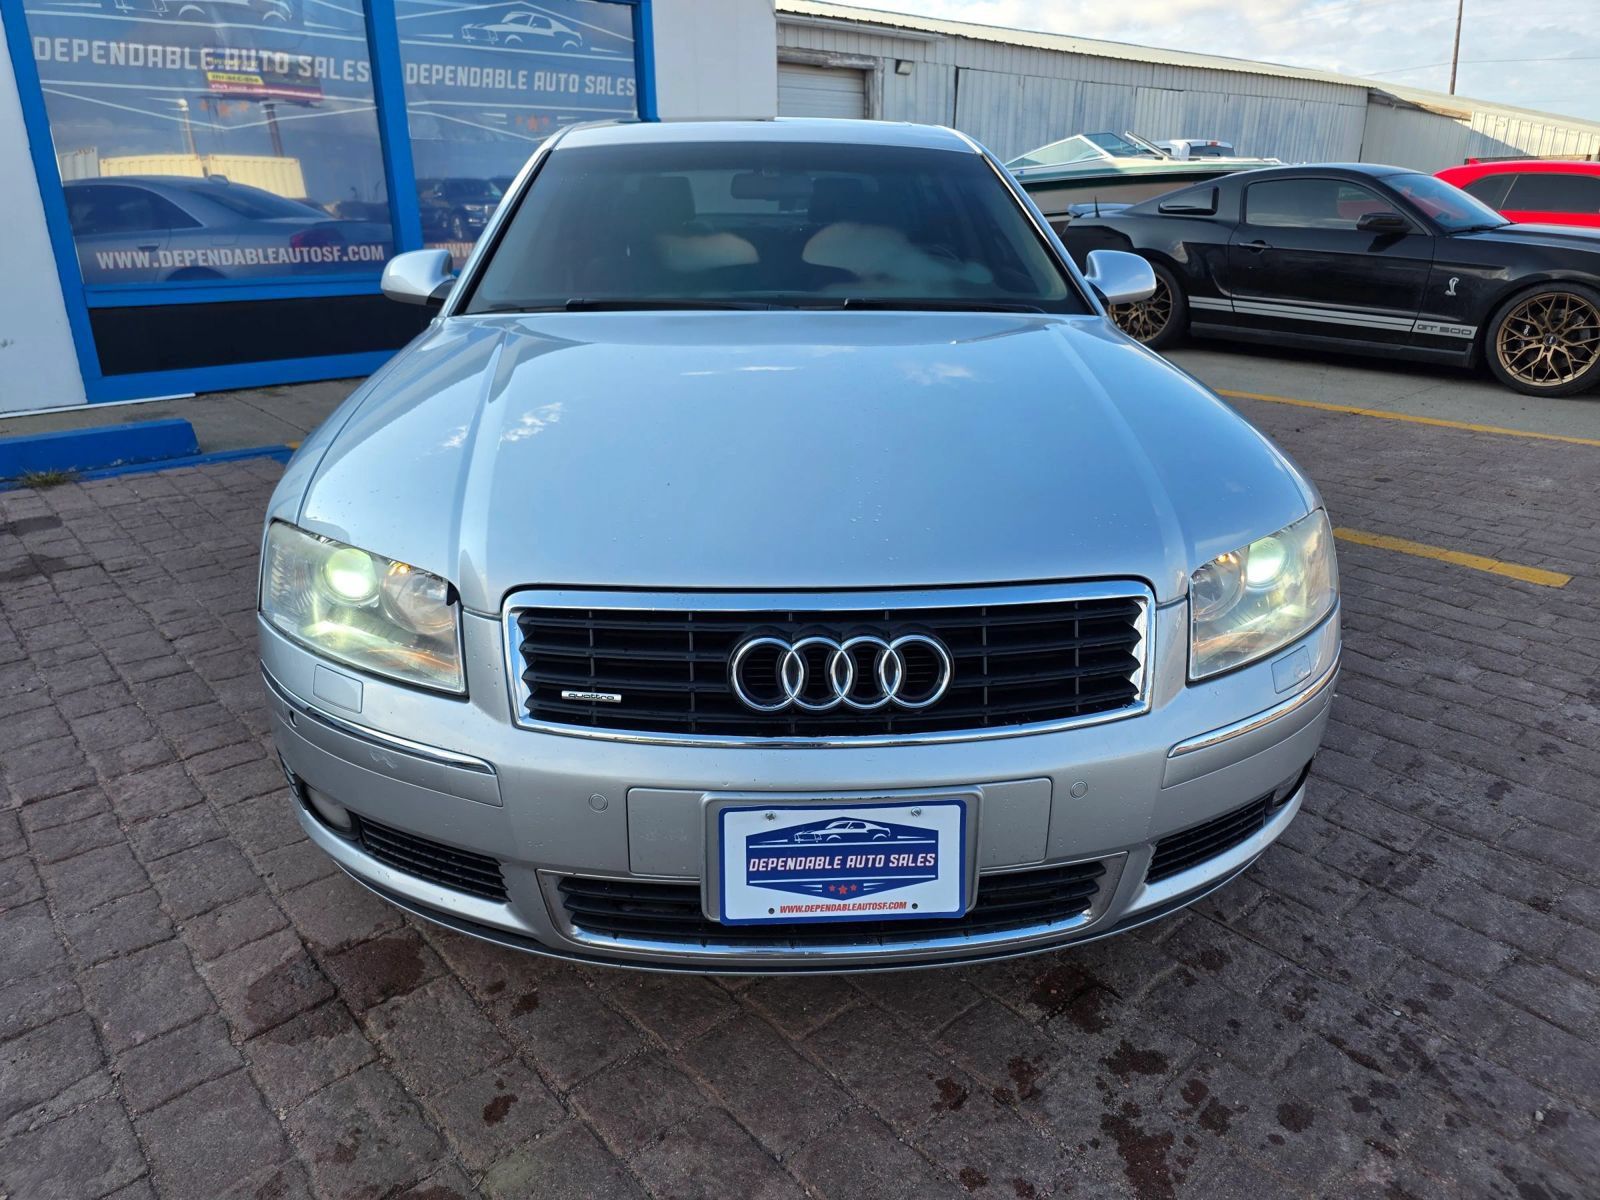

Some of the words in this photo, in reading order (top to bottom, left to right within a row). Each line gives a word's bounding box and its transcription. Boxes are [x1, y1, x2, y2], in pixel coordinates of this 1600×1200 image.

[34, 36, 214, 71] DEPENDABLE
[223, 47, 289, 74] AUTO
[297, 55, 371, 83] SALES
[405, 62, 528, 90] DEPENDABLE
[533, 71, 580, 92] AUTO
[584, 75, 636, 96] SALES
[95, 245, 385, 270] WWW.DEPENDABLEAUTOSF.COM
[568, 693, 615, 701] quattro
[749, 855, 842, 872] DEPENDABLE
[846, 853, 885, 870] AUTO
[889, 852, 936, 868] SALES
[779, 901, 907, 914] WWW.DEPENDABLEAUTOSF.COM
